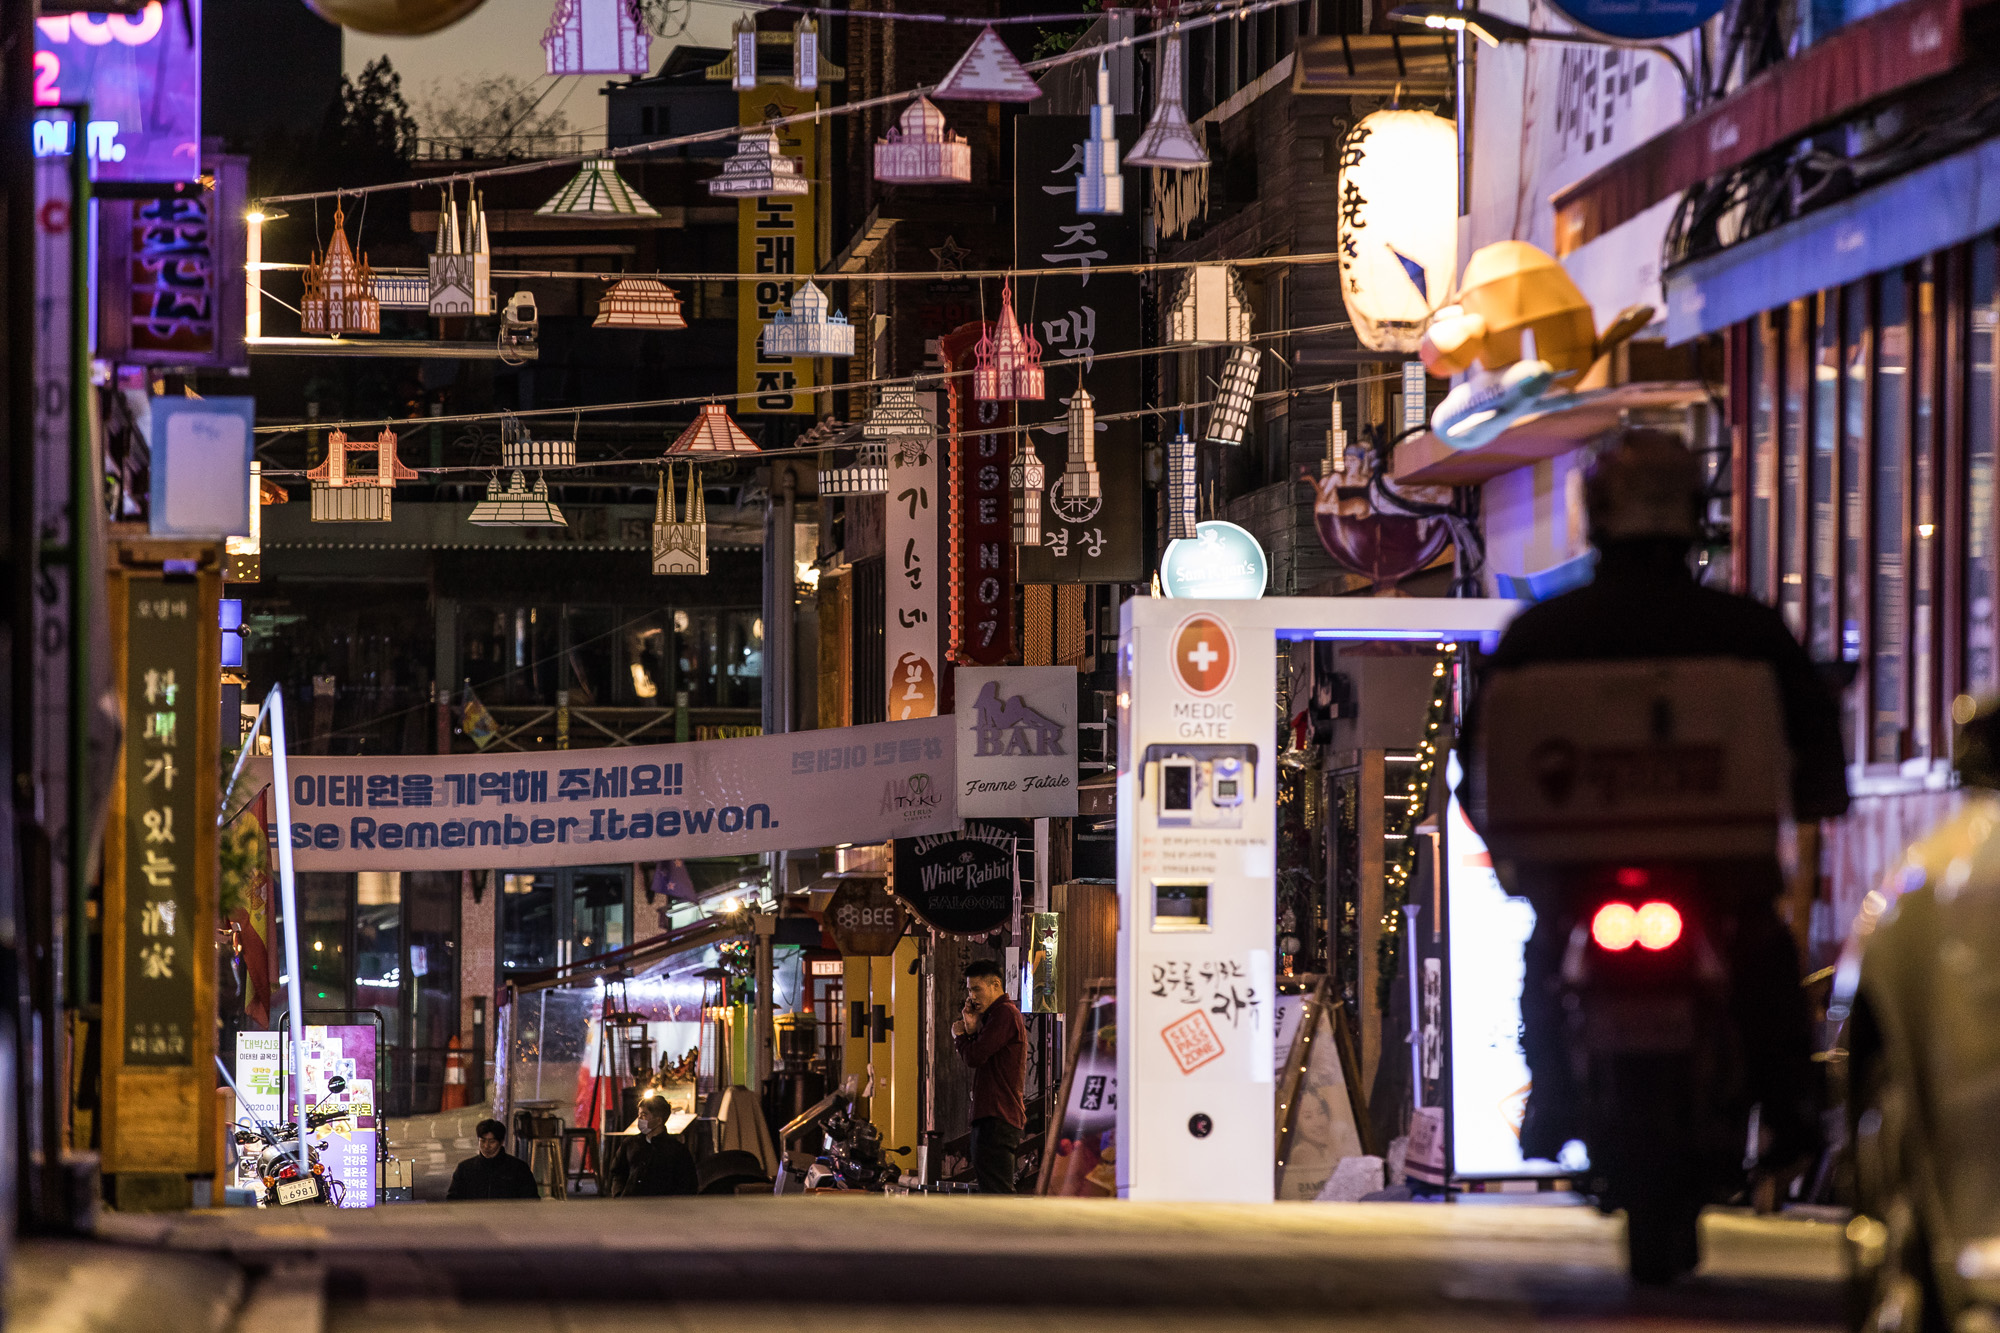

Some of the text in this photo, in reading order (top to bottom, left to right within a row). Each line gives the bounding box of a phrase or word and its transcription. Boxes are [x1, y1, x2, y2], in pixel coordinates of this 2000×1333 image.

[978, 400, 999, 524] OUSE
[1044, 527, 1108, 557] 겸상
[1175, 559, 1256, 582] Sam Ryan's
[1173, 703, 1234, 720] MEDIC
[1179, 722, 1227, 738] GATE
[970, 726, 1068, 757] BAR
[294, 763, 683, 807] 이태원을 기억해 주세요!!
[965, 774, 1070, 796] Femme Fatale
[903, 809, 932, 817] CITRUS
[350, 812, 579, 849] Remember
[588, 803, 779, 842] Itaewon.
[920, 857, 1012, 892] White Rabbit
[928, 896, 1005, 910] SALOON
[862, 908, 894, 925] BEE
[1151, 960, 1245, 1004] 모두를 위한
[1170, 1018, 1202, 1045] SELF
[1176, 1030, 1209, 1054] PASS
[1184, 1042, 1216, 1066] ZONE
[342, 1143, 368, 1154] 시험운
[342, 1155, 368, 1166] 건강운
[342, 1167, 368, 1177] 결혼운
[289, 1186, 314, 1200] 6981
[342, 1178, 368, 1189] 진학운
[343, 1190, 368, 1200] 이사운
